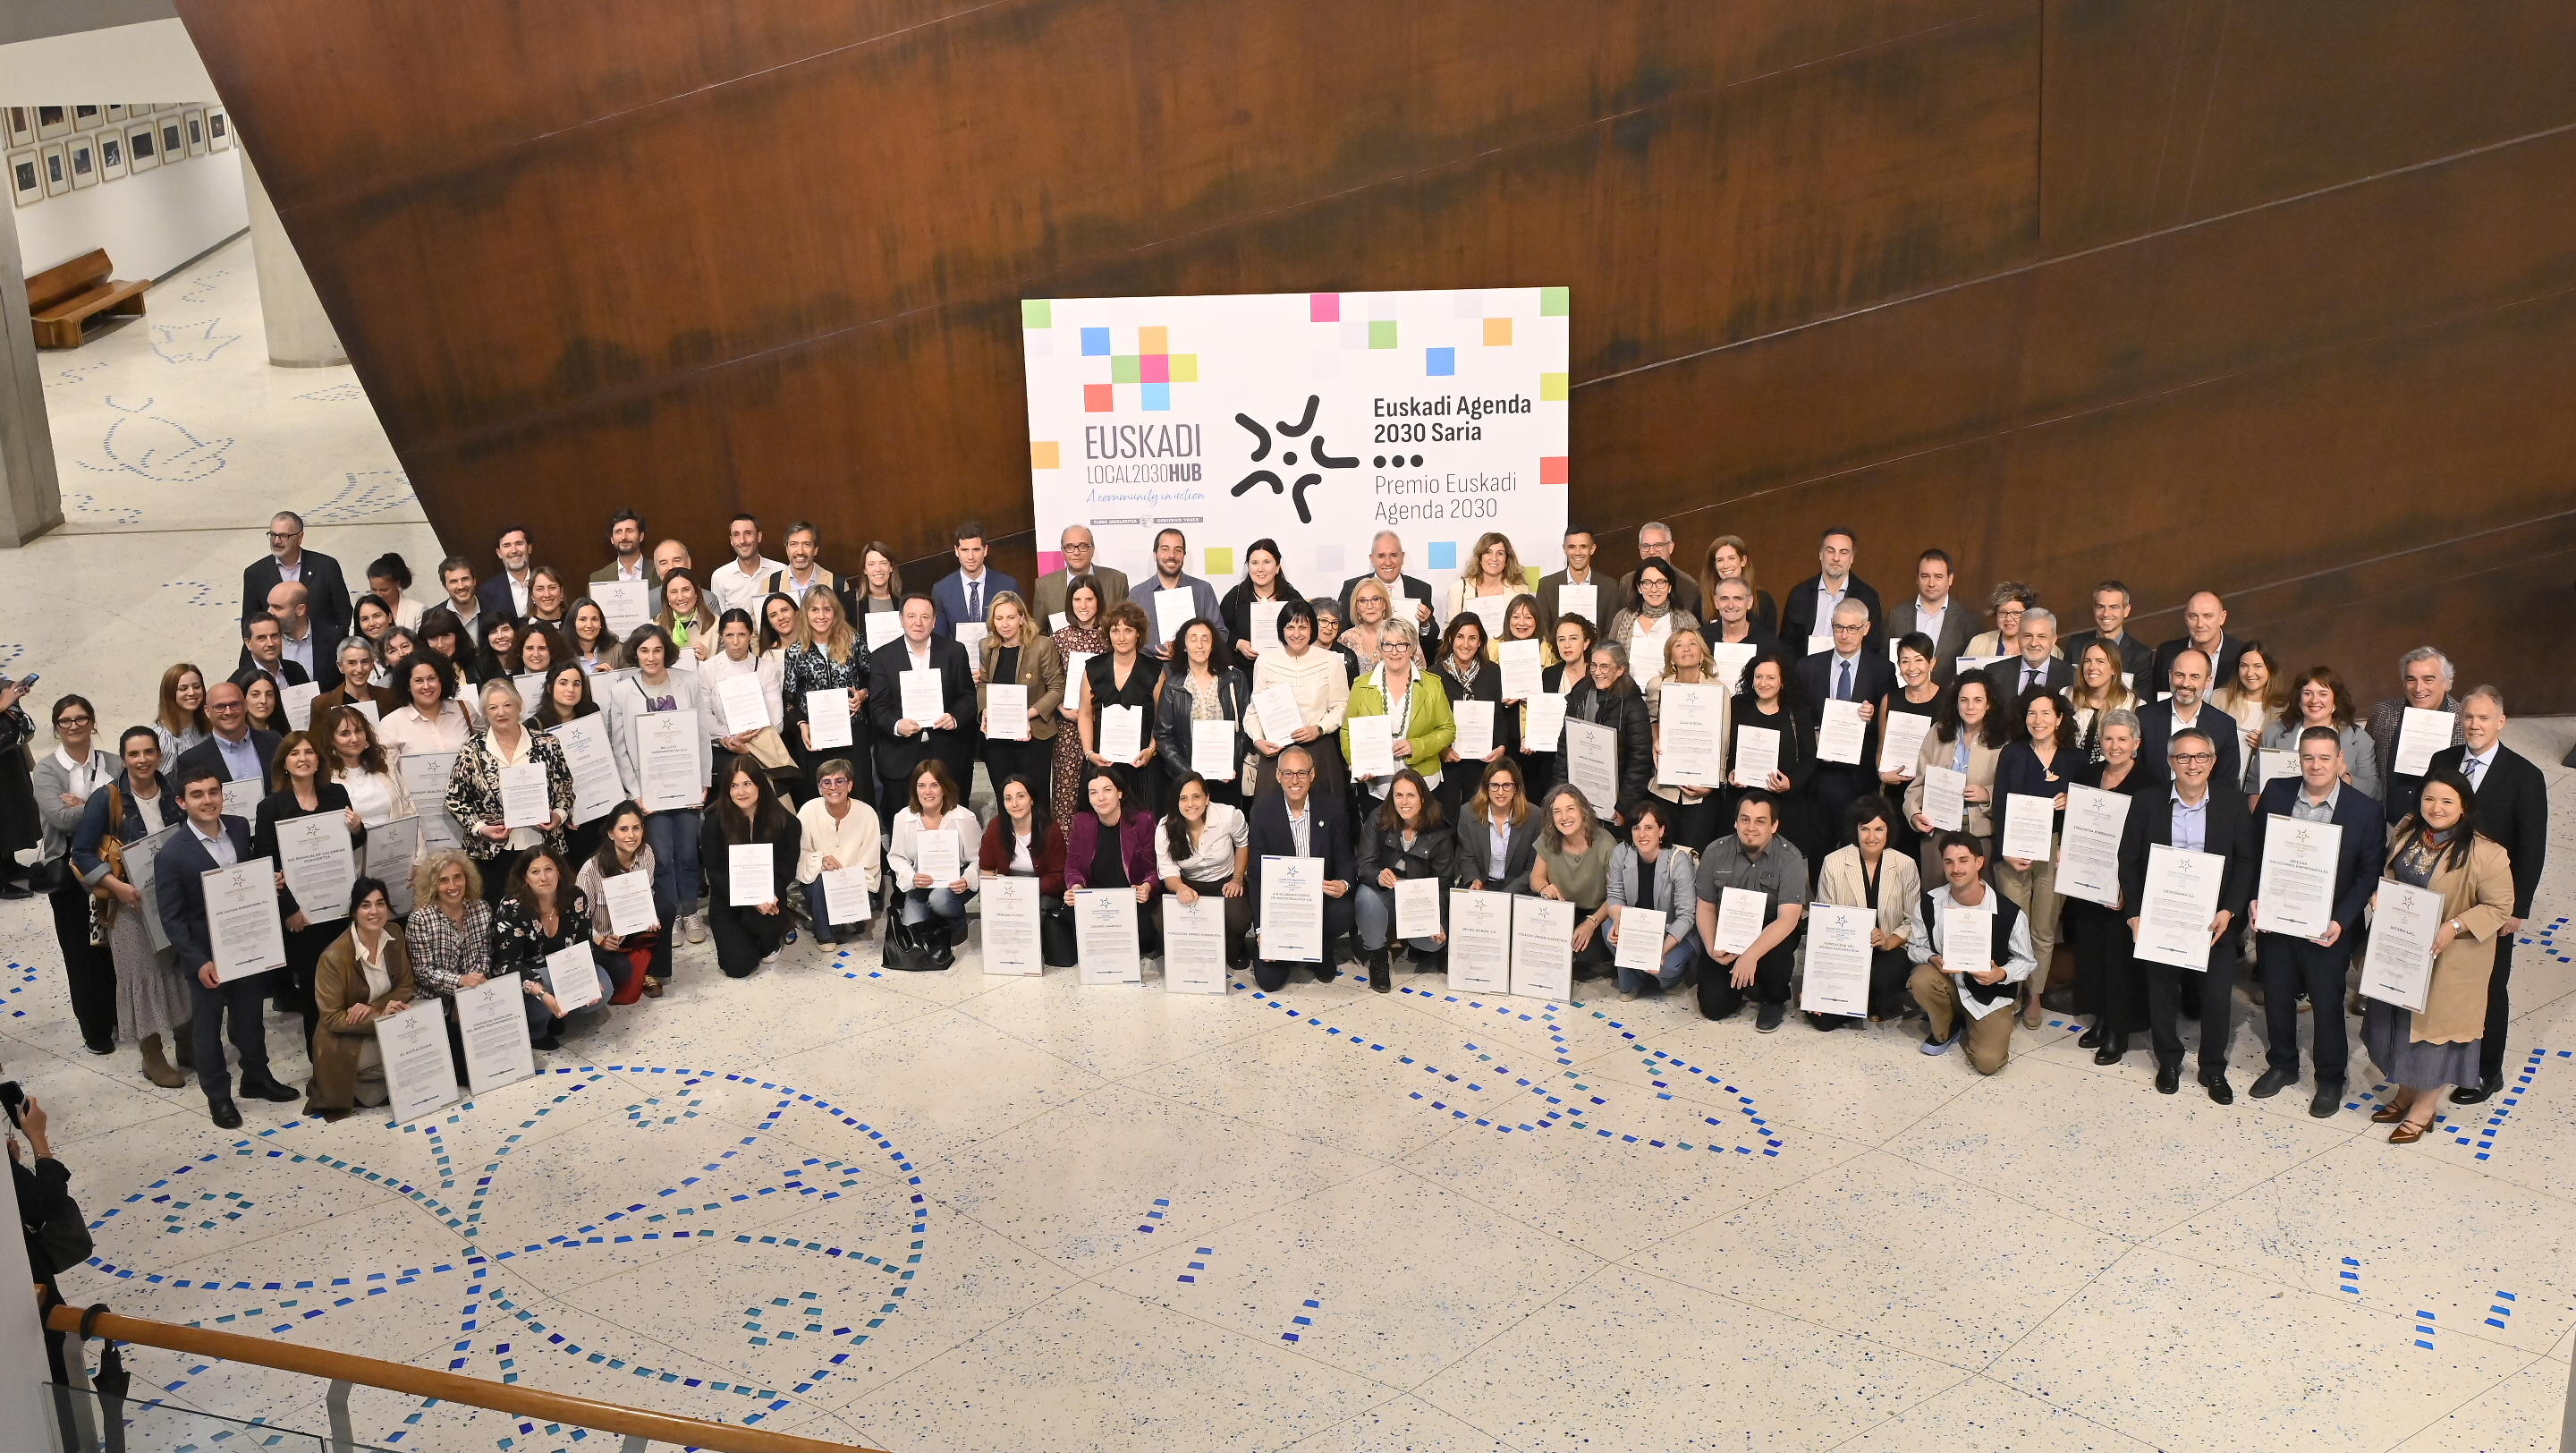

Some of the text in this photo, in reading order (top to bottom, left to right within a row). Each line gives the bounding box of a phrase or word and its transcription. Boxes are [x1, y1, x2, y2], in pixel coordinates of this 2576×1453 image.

[1374, 394, 1531, 420] Euskadi Agenda
[1085, 423, 1201, 459] EUSKADI
[1374, 421, 1482, 443] 2030 Saria
[1087, 463, 1202, 484] LOCAL2030HUB
[1376, 472, 1517, 494] Premio Euskadi
[1086, 489, 1206, 507] A community in action
[1375, 497, 1497, 525] Agenda 2030
